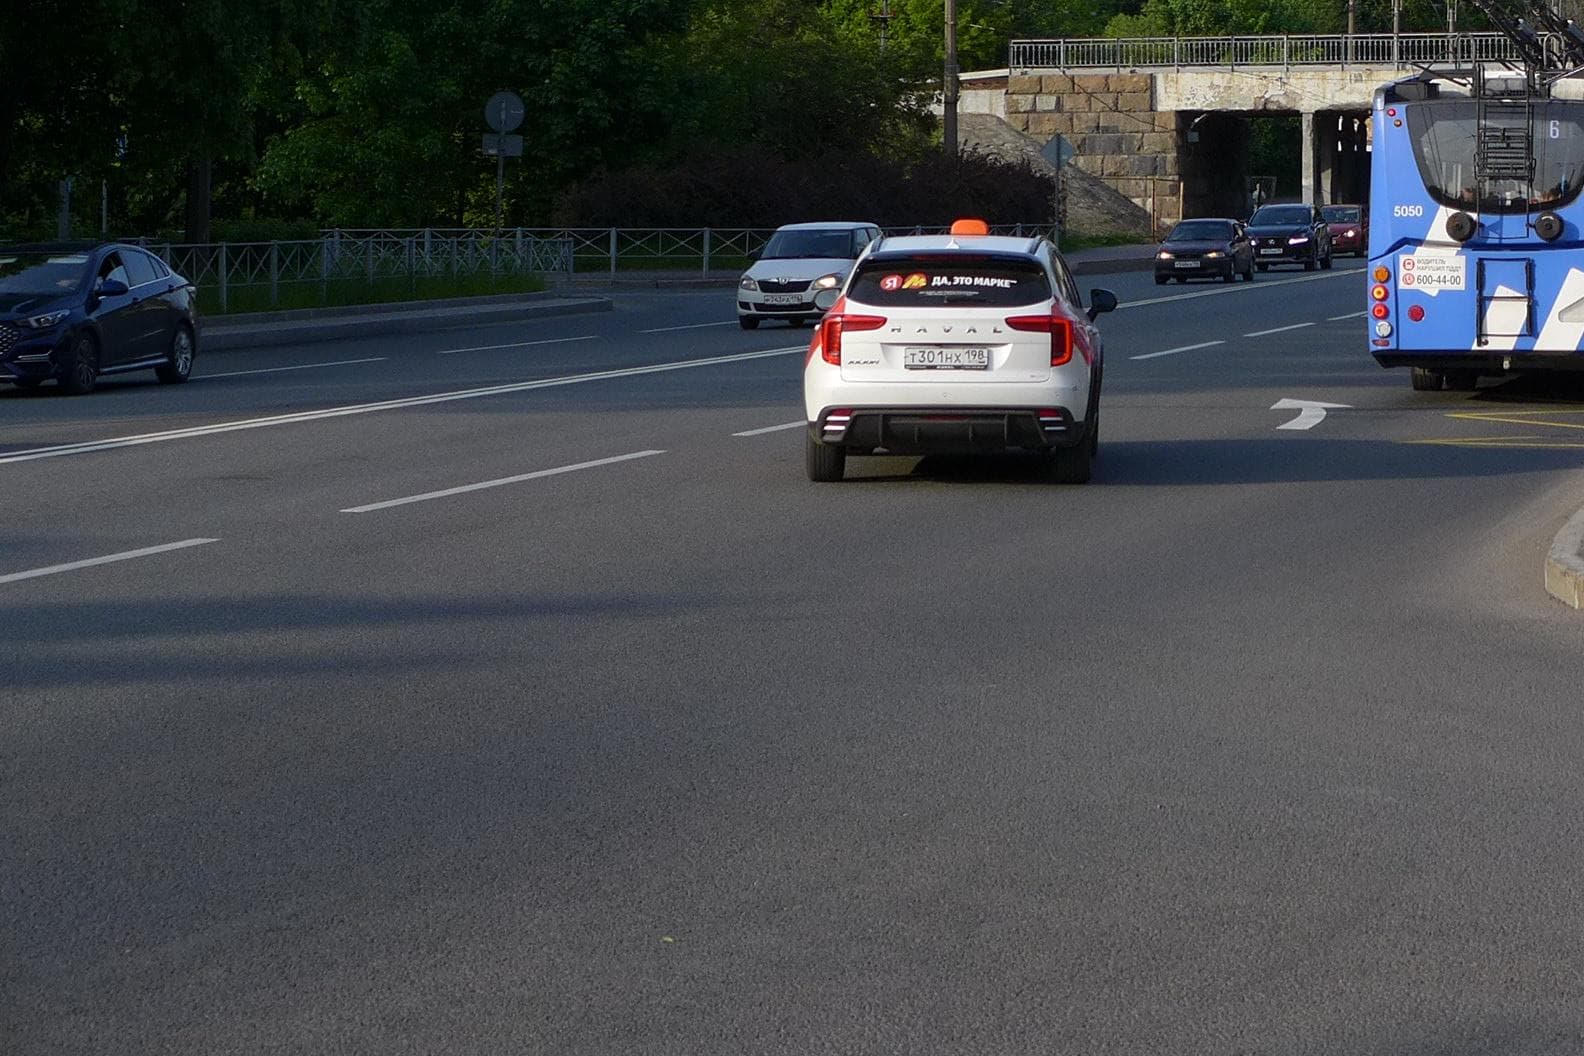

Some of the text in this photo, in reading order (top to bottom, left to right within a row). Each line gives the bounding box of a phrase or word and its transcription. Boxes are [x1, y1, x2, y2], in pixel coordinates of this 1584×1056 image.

[1550, 120, 1559, 139] 6
[1393, 205, 1423, 217] 5050
[931, 276, 952, 288] ДА,
[953, 277, 973, 287] ЭТО
[1416, 274, 1462, 286] 600-44-00
[965, 350, 985, 361] 198
